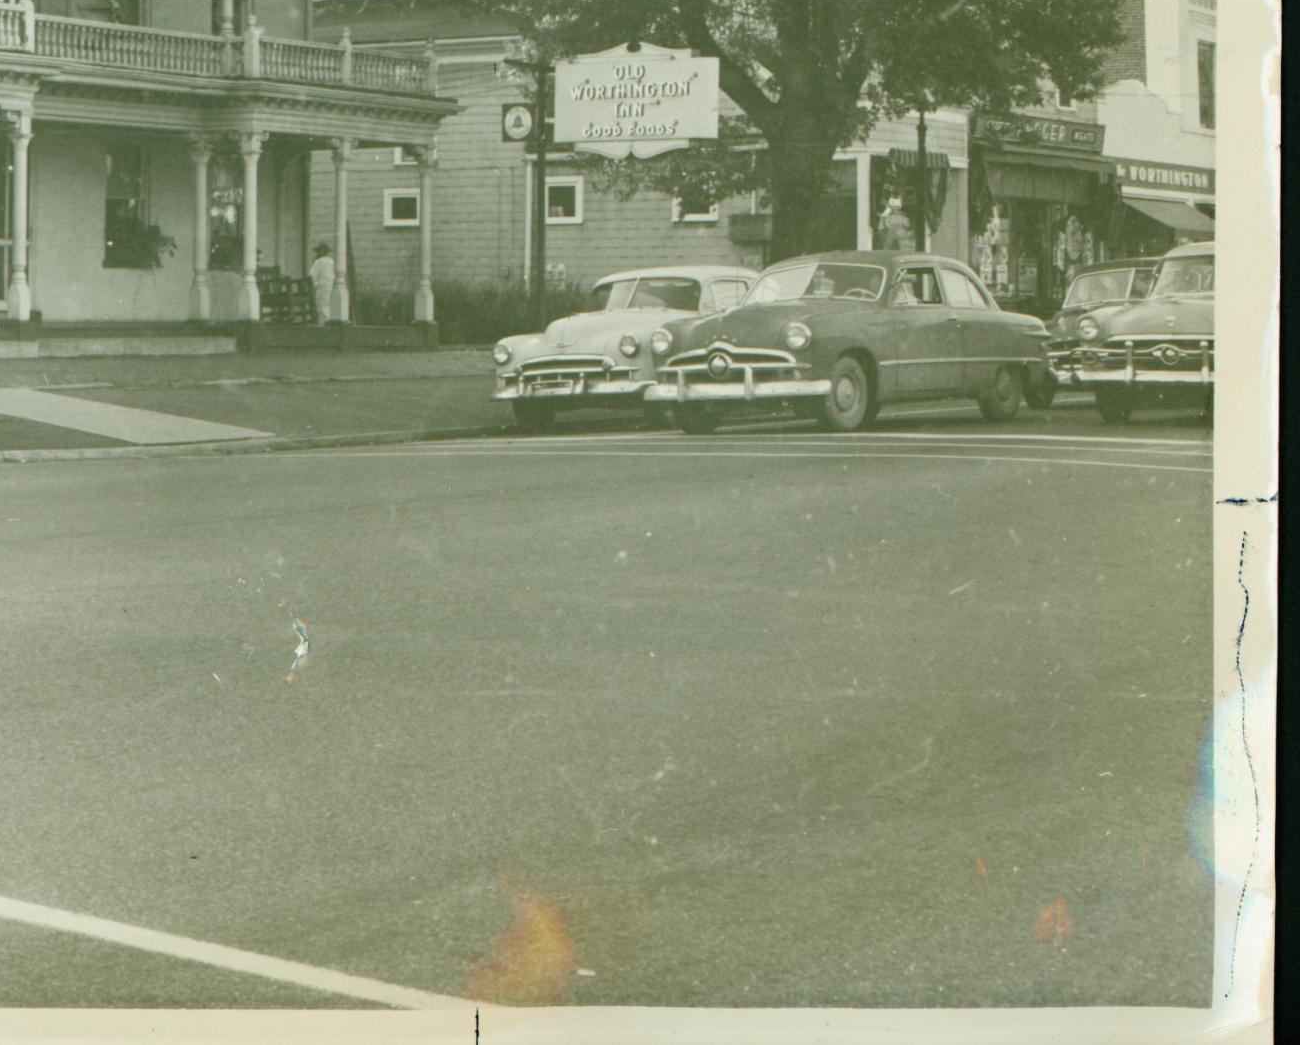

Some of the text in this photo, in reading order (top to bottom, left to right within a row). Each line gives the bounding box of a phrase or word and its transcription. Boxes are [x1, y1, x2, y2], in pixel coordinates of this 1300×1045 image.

[614, 64, 646, 81] OLD
[571, 80, 691, 101] WORTHINGTON
[615, 102, 645, 118] INN
[584, 123, 677, 138] GOOD FOODS
[1129, 165, 1209, 188] WORTHINGTON
